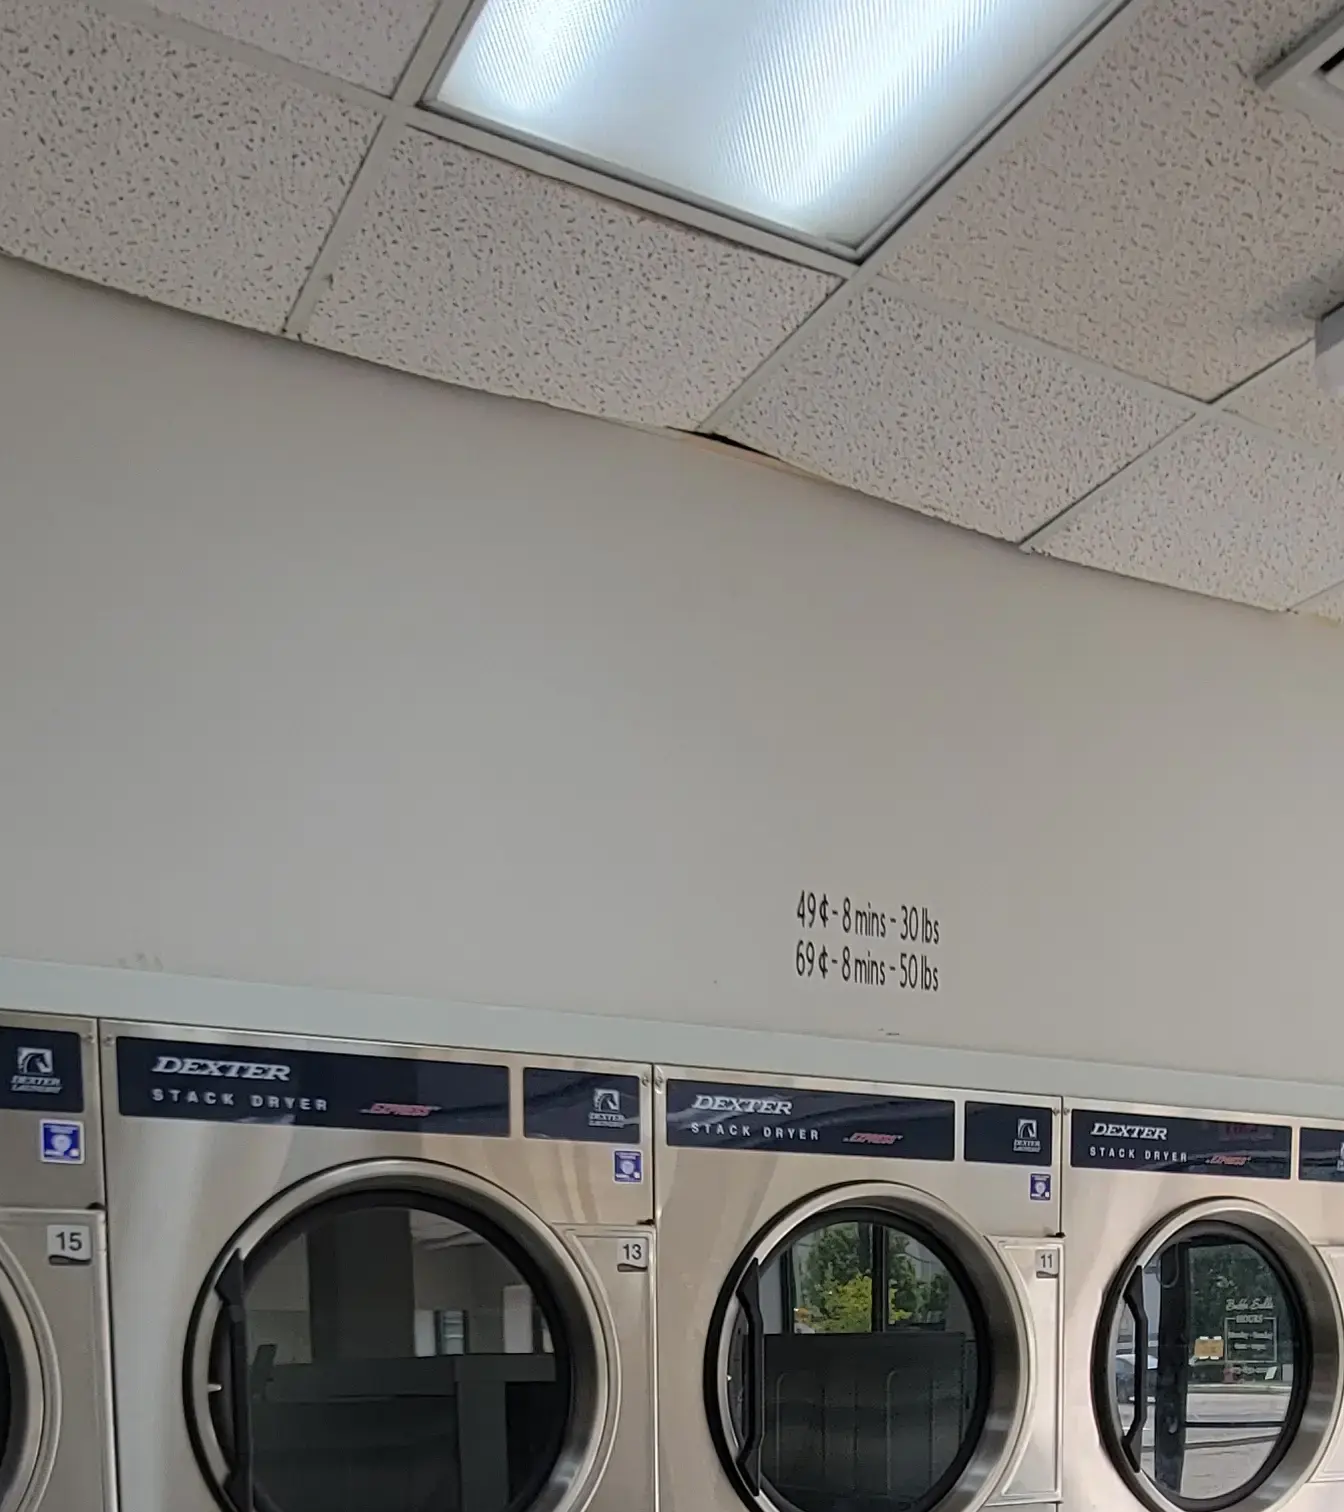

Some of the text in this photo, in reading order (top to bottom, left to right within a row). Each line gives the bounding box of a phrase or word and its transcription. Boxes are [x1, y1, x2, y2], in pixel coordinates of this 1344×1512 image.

[842, 897, 852, 934] 8
[855, 901, 886, 938] mins
[900, 904, 919, 942] 30
[921, 906, 940, 945] lbs
[841, 945, 851, 982] 8
[854, 950, 886, 986] mins
[899, 952, 918, 989] 50
[920, 954, 939, 992] lbs
[152, 1055, 291, 1082] DEXTER
[151, 1088, 328, 1112] STACK DRYER
[690, 1094, 793, 1116] DEXTER
[690, 1121, 820, 1141] STACK DRYER
[1090, 1122, 1168, 1141] DEXTER
[1089, 1146, 1188, 1163] STACK DRYER
[55, 1231, 83, 1252] 15
[622, 1243, 643, 1261] 13
[1040, 1253, 1053, 1269] 11
